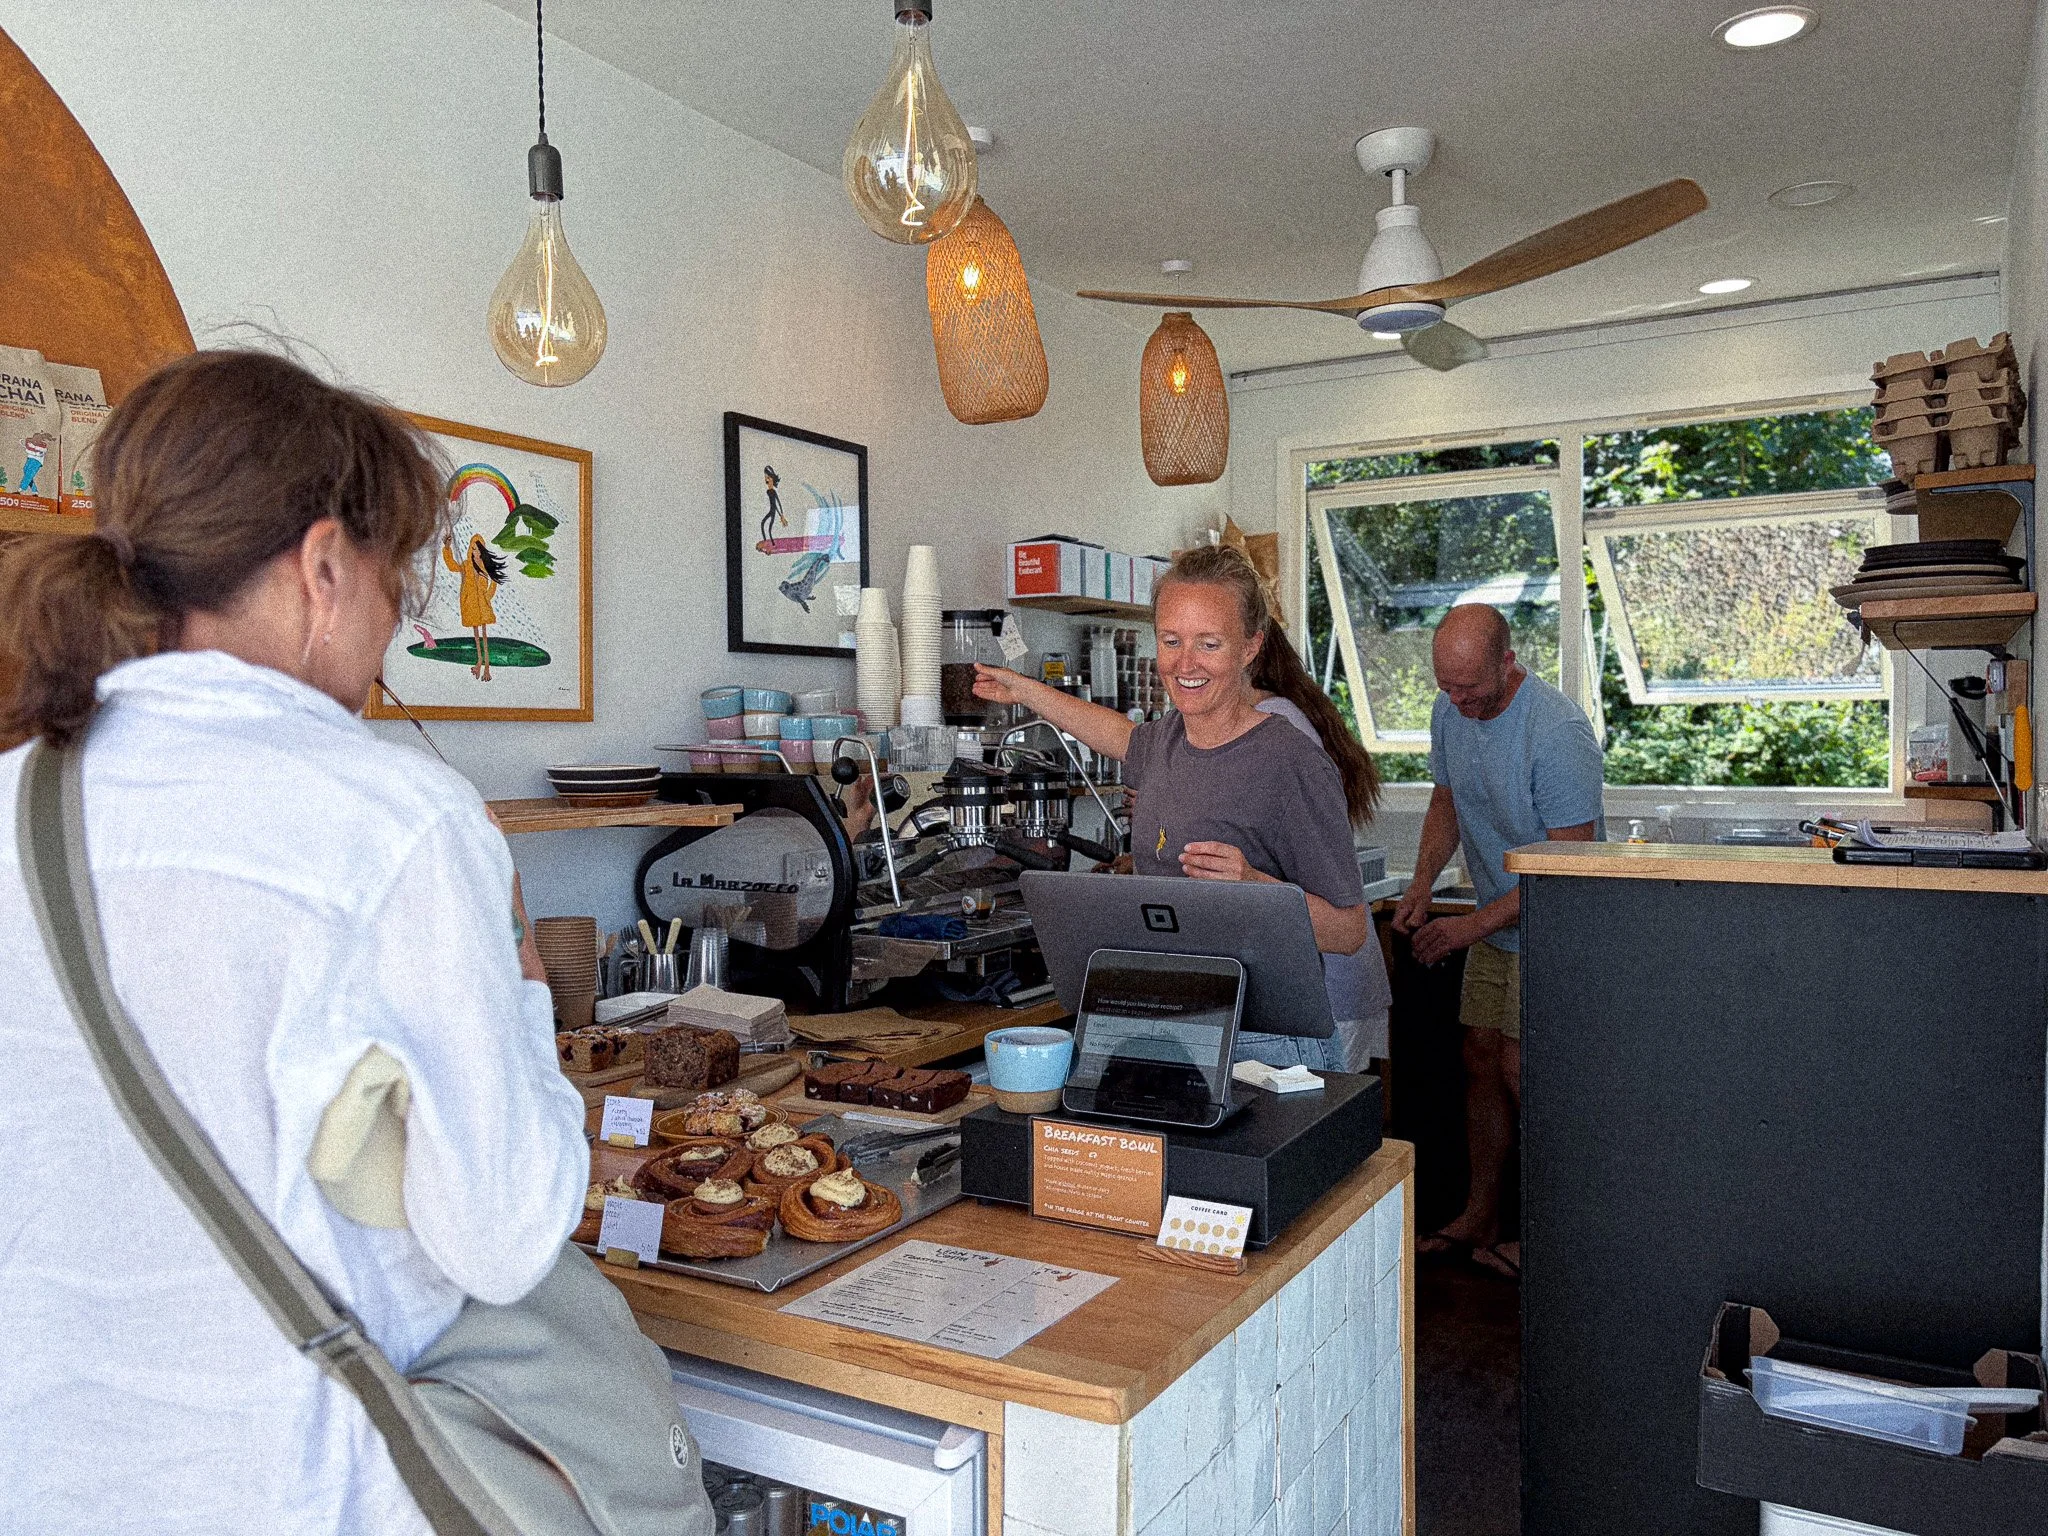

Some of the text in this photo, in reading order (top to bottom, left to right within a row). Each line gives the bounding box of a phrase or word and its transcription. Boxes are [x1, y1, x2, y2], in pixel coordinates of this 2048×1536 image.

[0, 373, 43, 391] RANA
[54, 389, 94, 403] RANA
[70, 409, 108, 419] ORIGINAL
[71, 416, 98, 424] BLEND
[1043, 1125, 1158, 1154] BREAKFAST BOWL
[1043, 1145, 1059, 1154] CHIA
[1190, 1205, 1211, 1214] COFFEE
[811, 1502, 898, 1536] POLAR
